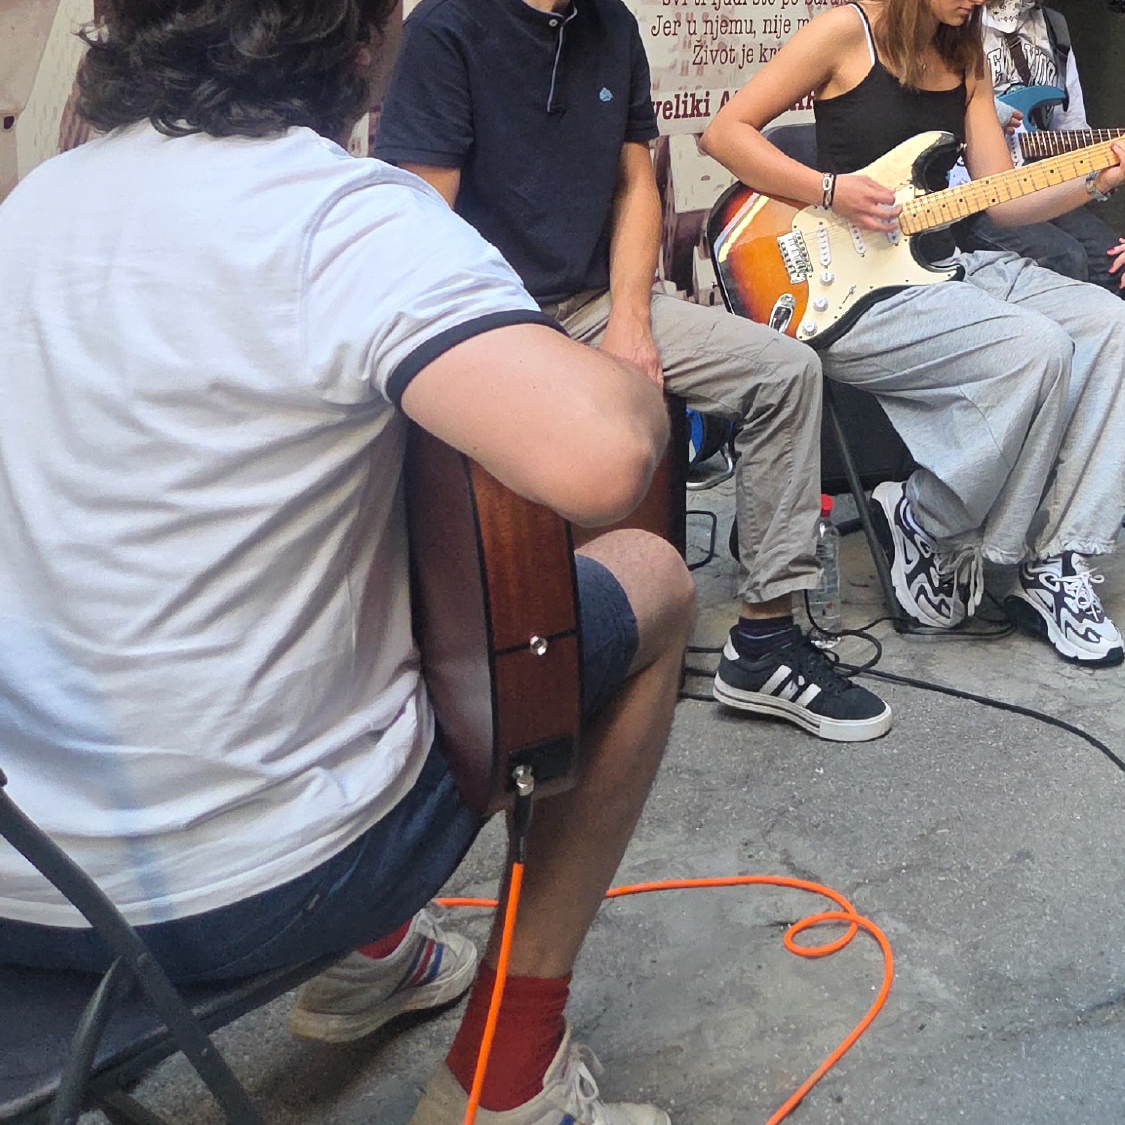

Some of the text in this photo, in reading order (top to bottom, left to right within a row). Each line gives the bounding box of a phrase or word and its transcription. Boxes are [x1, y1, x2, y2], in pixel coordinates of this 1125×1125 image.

[651, 15, 681, 36] Jer
[687, 20, 697, 35] u
[703, 15, 756, 41] njemu,
[763, 15, 790, 39] nije
[693, 39, 735, 65] Život
[739, 44, 753, 69] je
[651, 91, 710, 120] veliki
